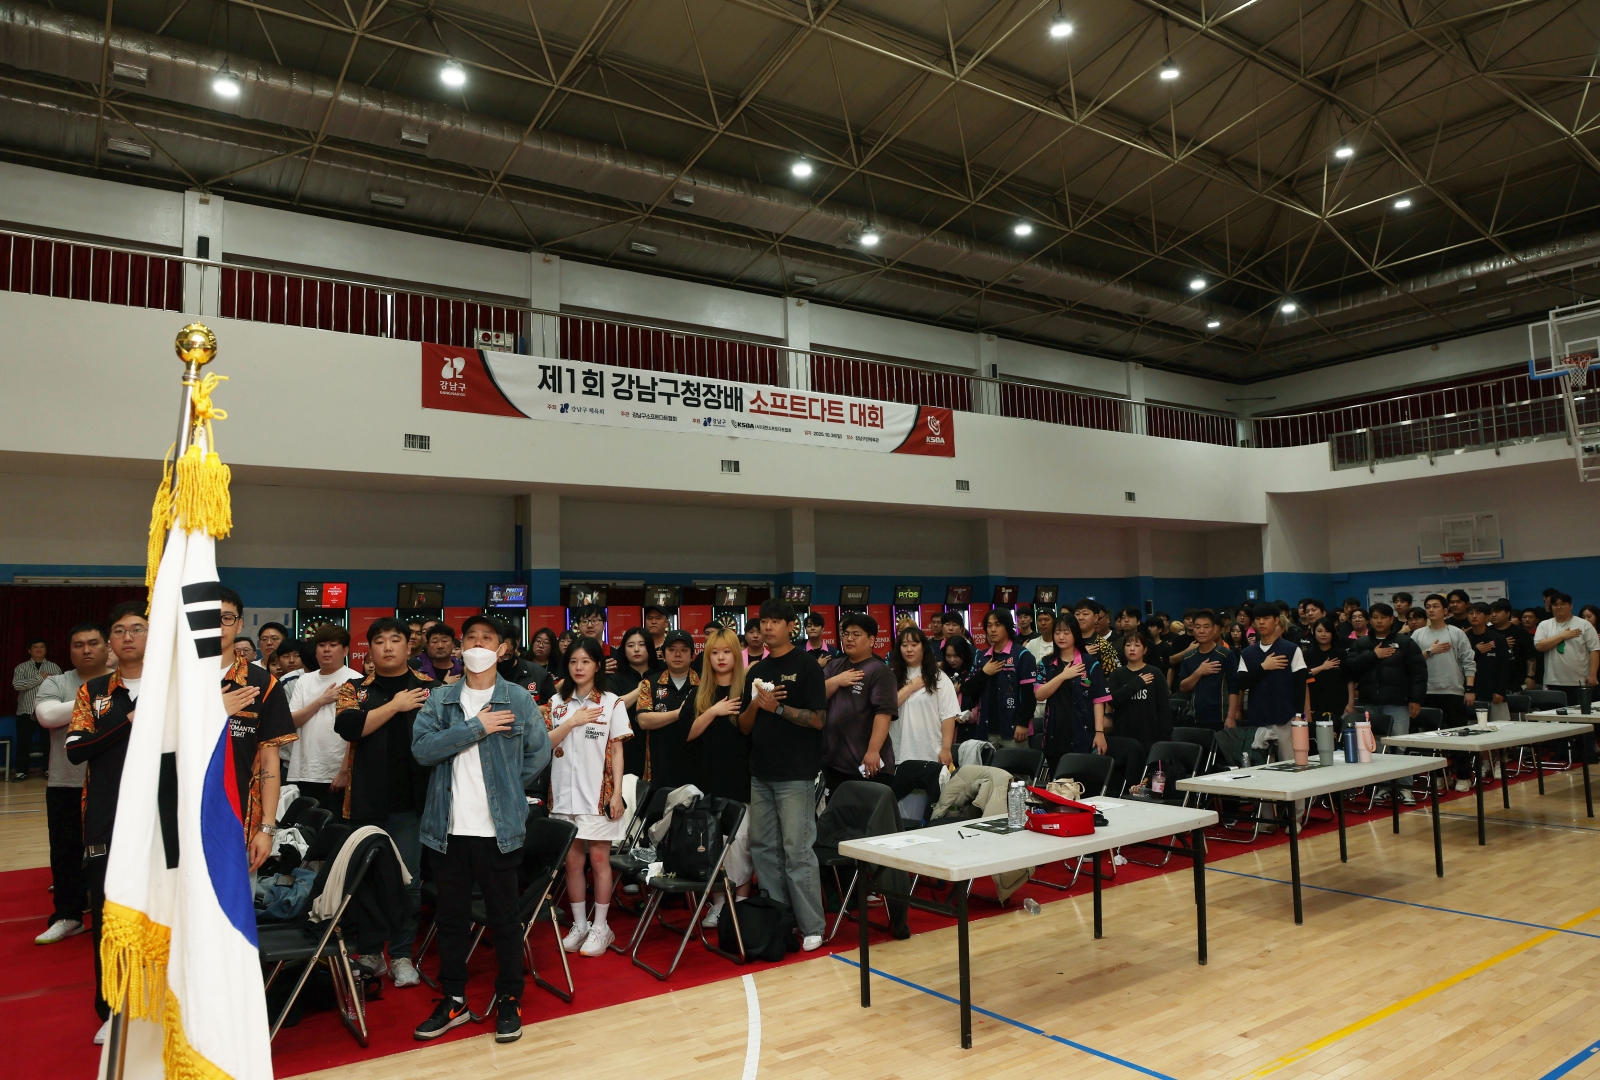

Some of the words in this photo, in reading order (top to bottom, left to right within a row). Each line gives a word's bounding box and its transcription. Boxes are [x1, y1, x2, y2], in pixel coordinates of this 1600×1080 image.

[439, 380, 467, 392] 강남구
[537, 364, 604, 398] 제1회
[611, 372, 744, 412] 강남구청장배
[749, 390, 845, 424] 소프트다트
[849, 402, 884, 429] 대회
[230, 730, 246, 738] LIGHT
